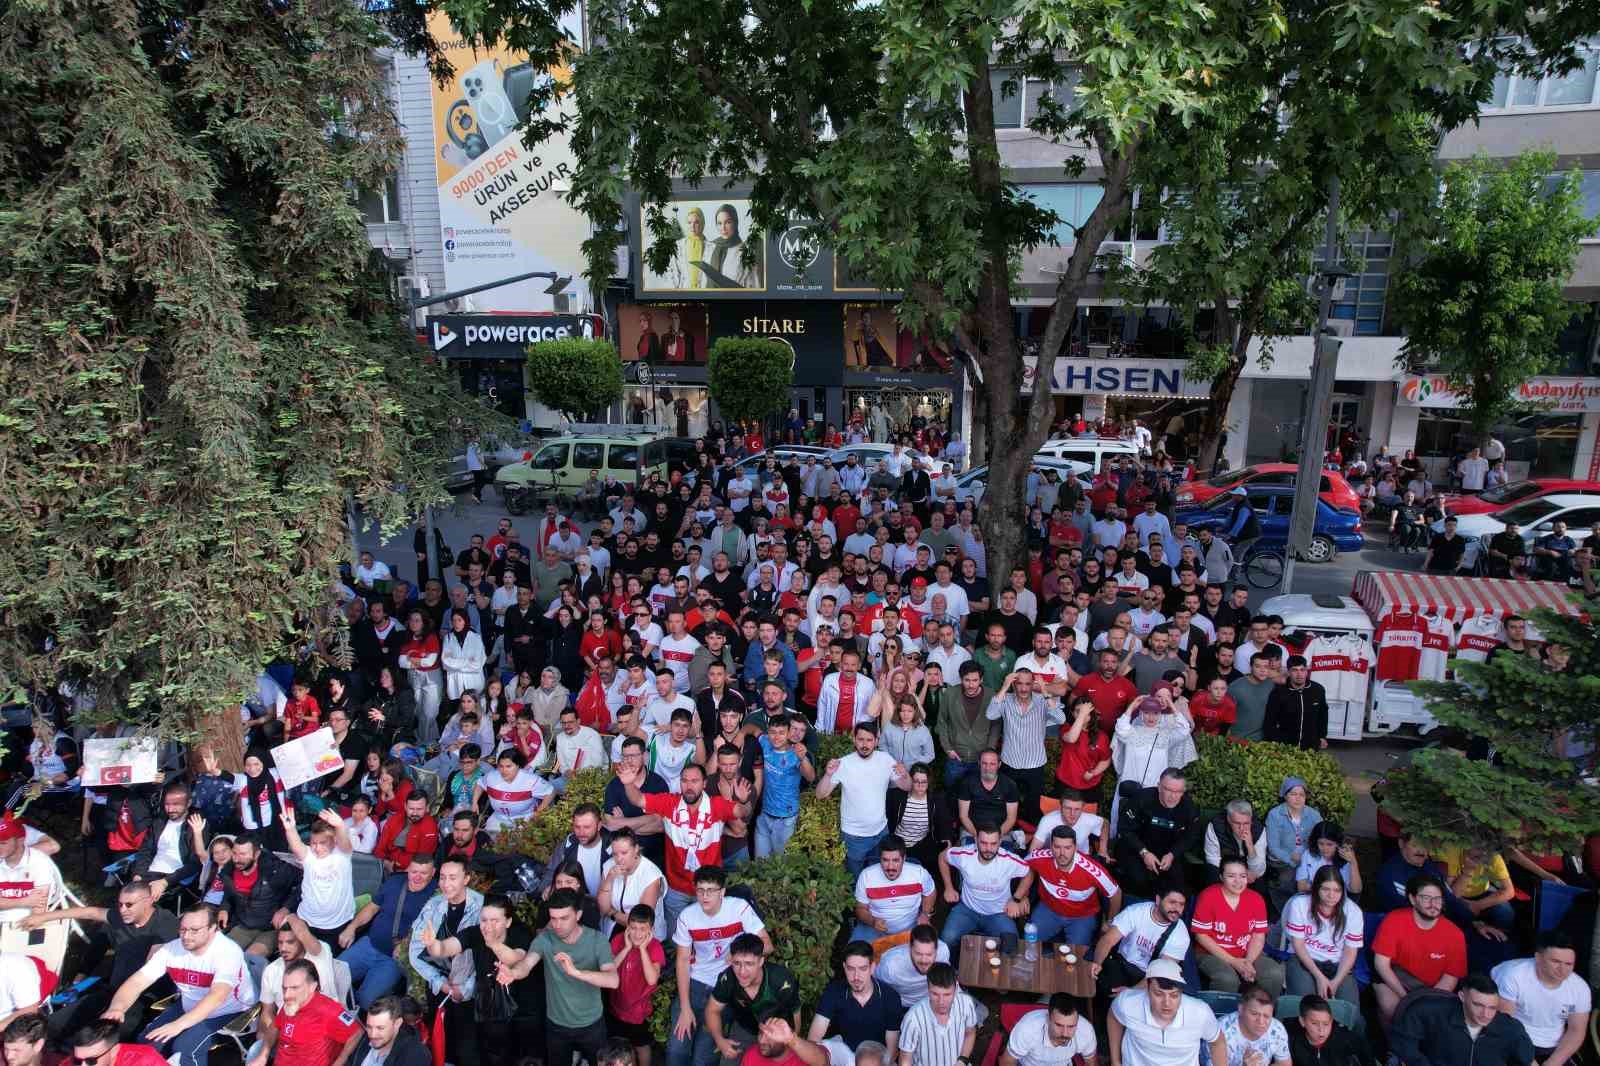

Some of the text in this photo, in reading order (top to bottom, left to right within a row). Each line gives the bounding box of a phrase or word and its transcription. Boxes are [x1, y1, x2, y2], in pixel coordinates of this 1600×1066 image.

[452, 146, 519, 199] 9000'DEN
[473, 154, 543, 206] ÜRÜN ve
[489, 161, 573, 224] AKSESUAR
[465, 325, 568, 346] powerace
[743, 316, 805, 334] SİTARE
